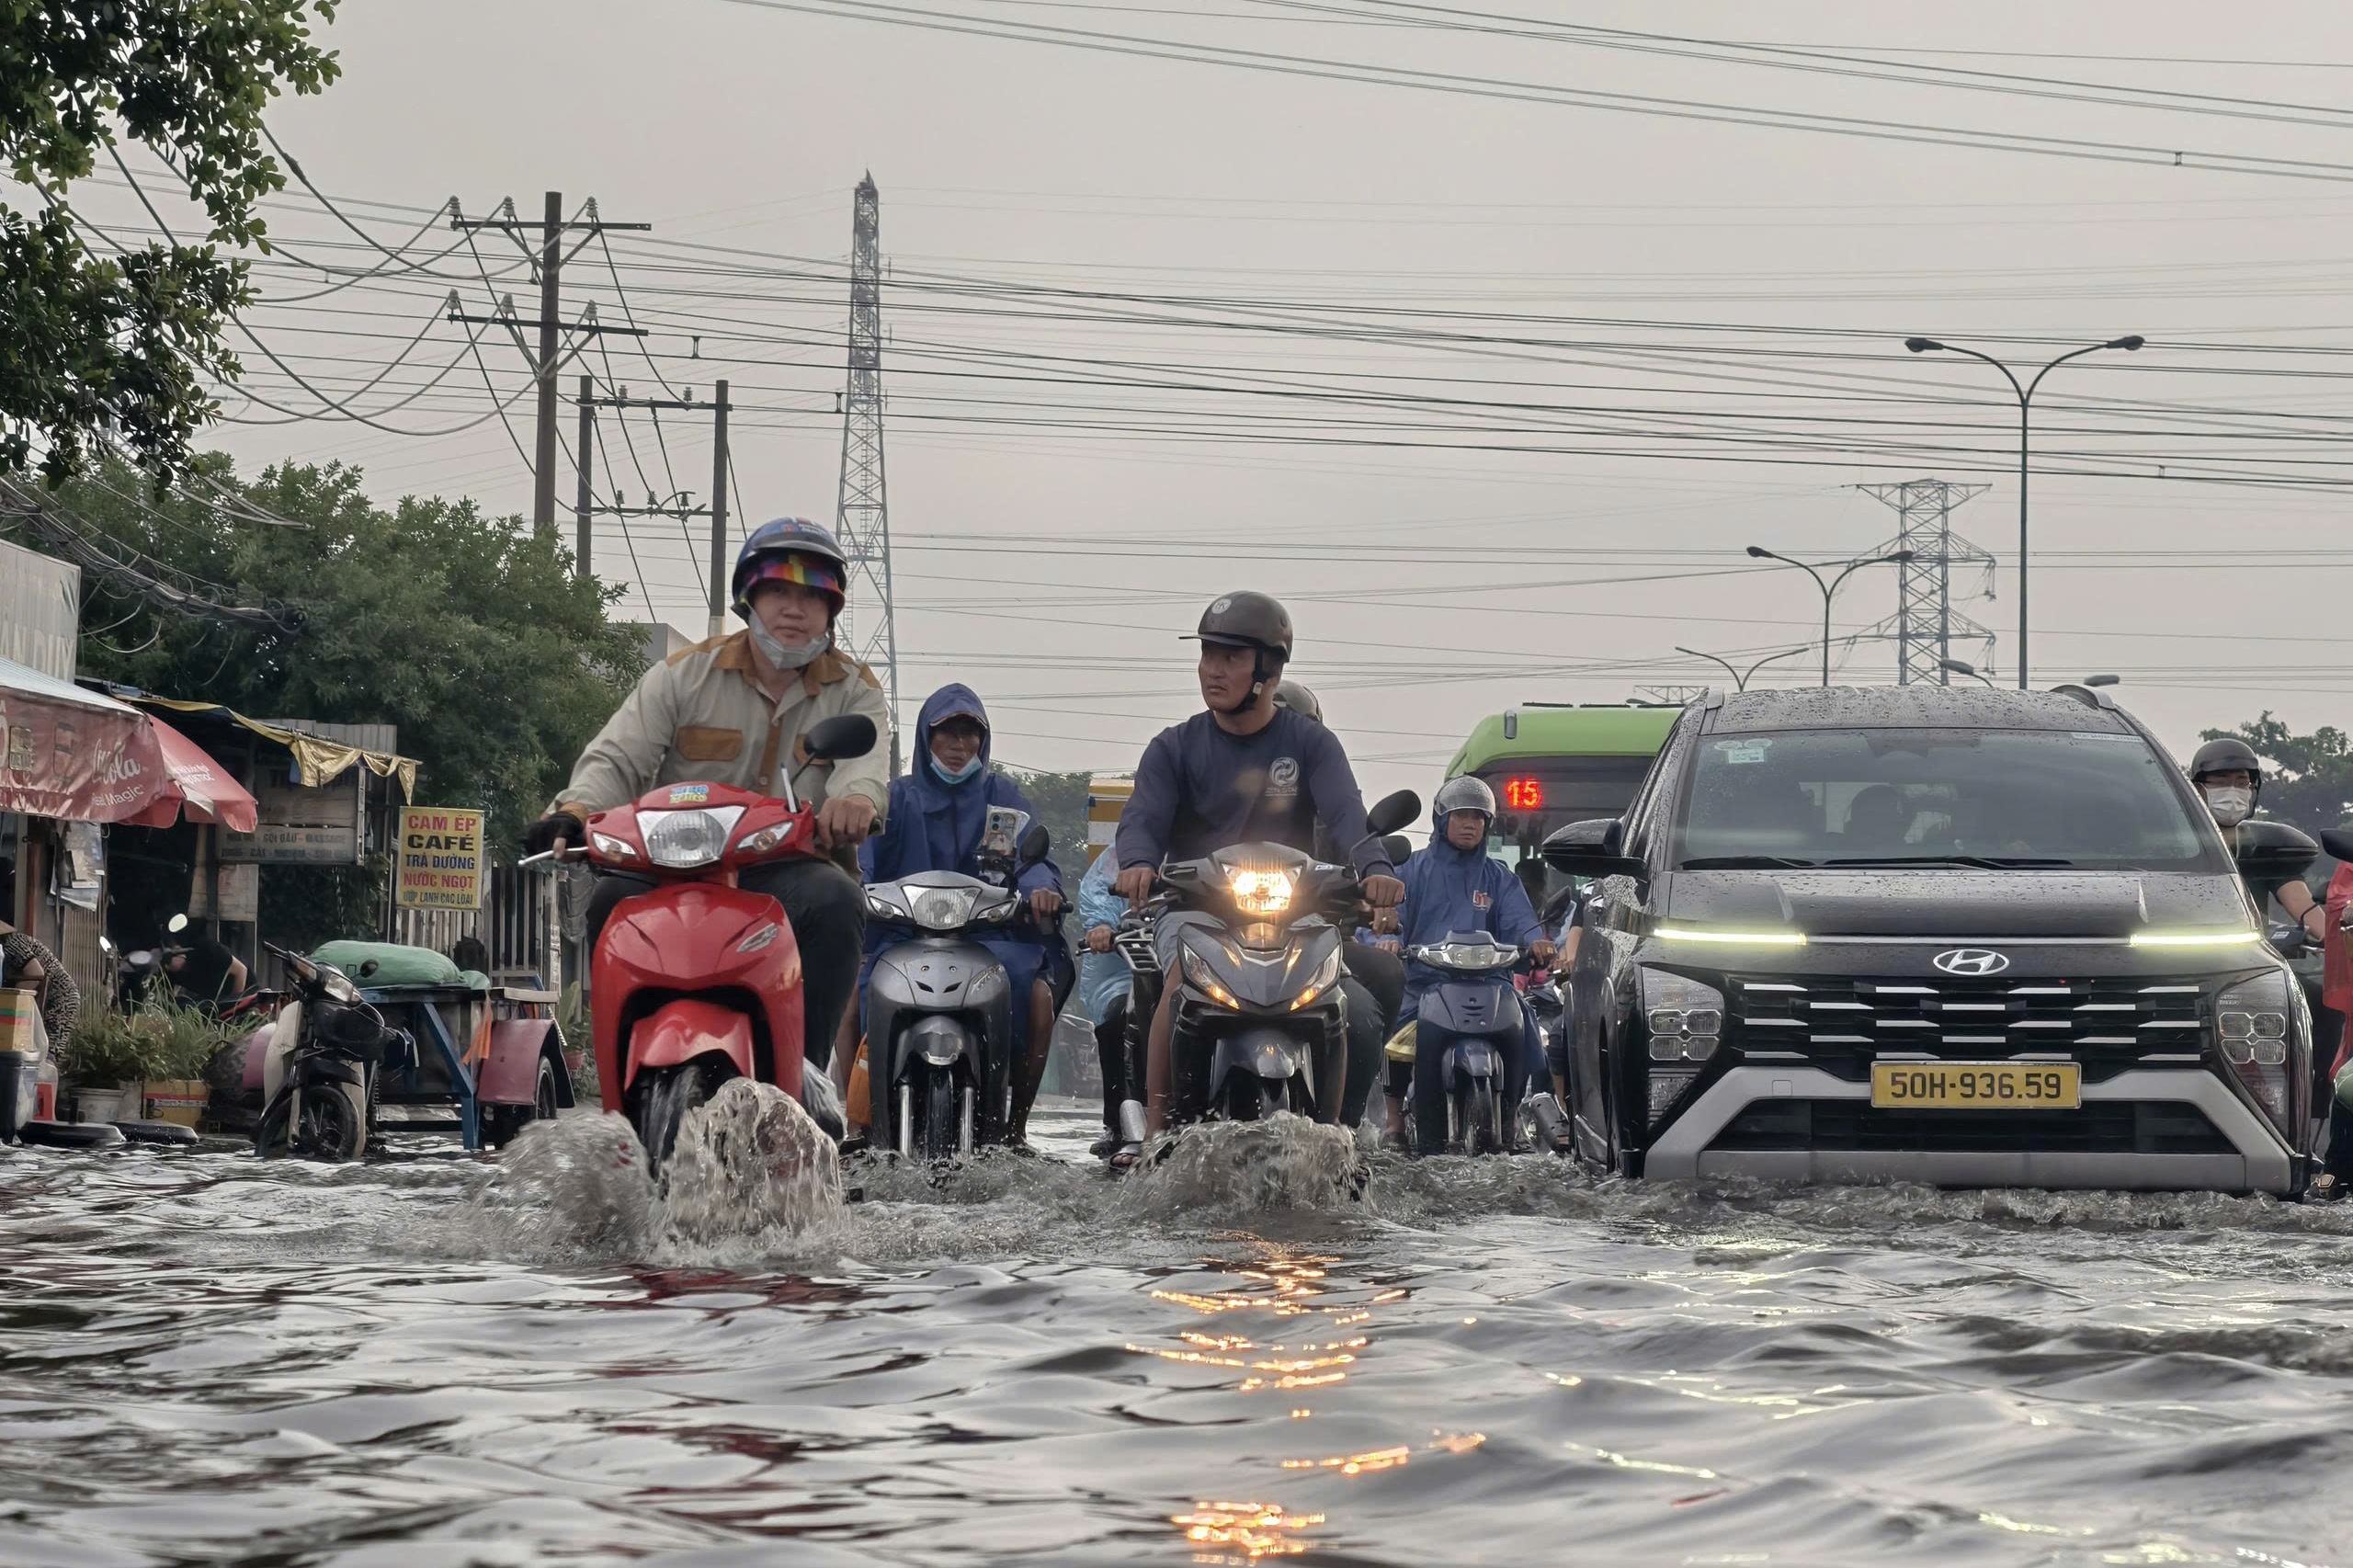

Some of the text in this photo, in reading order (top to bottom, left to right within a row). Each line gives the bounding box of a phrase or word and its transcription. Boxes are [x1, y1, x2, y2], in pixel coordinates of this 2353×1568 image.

[106, 785, 145, 806] Magic
[1507, 779, 1539, 806] 15
[408, 815, 448, 831] CAM
[407, 834, 474, 851] CAFÉ
[1891, 1072, 2061, 1099] 50H-936.59
